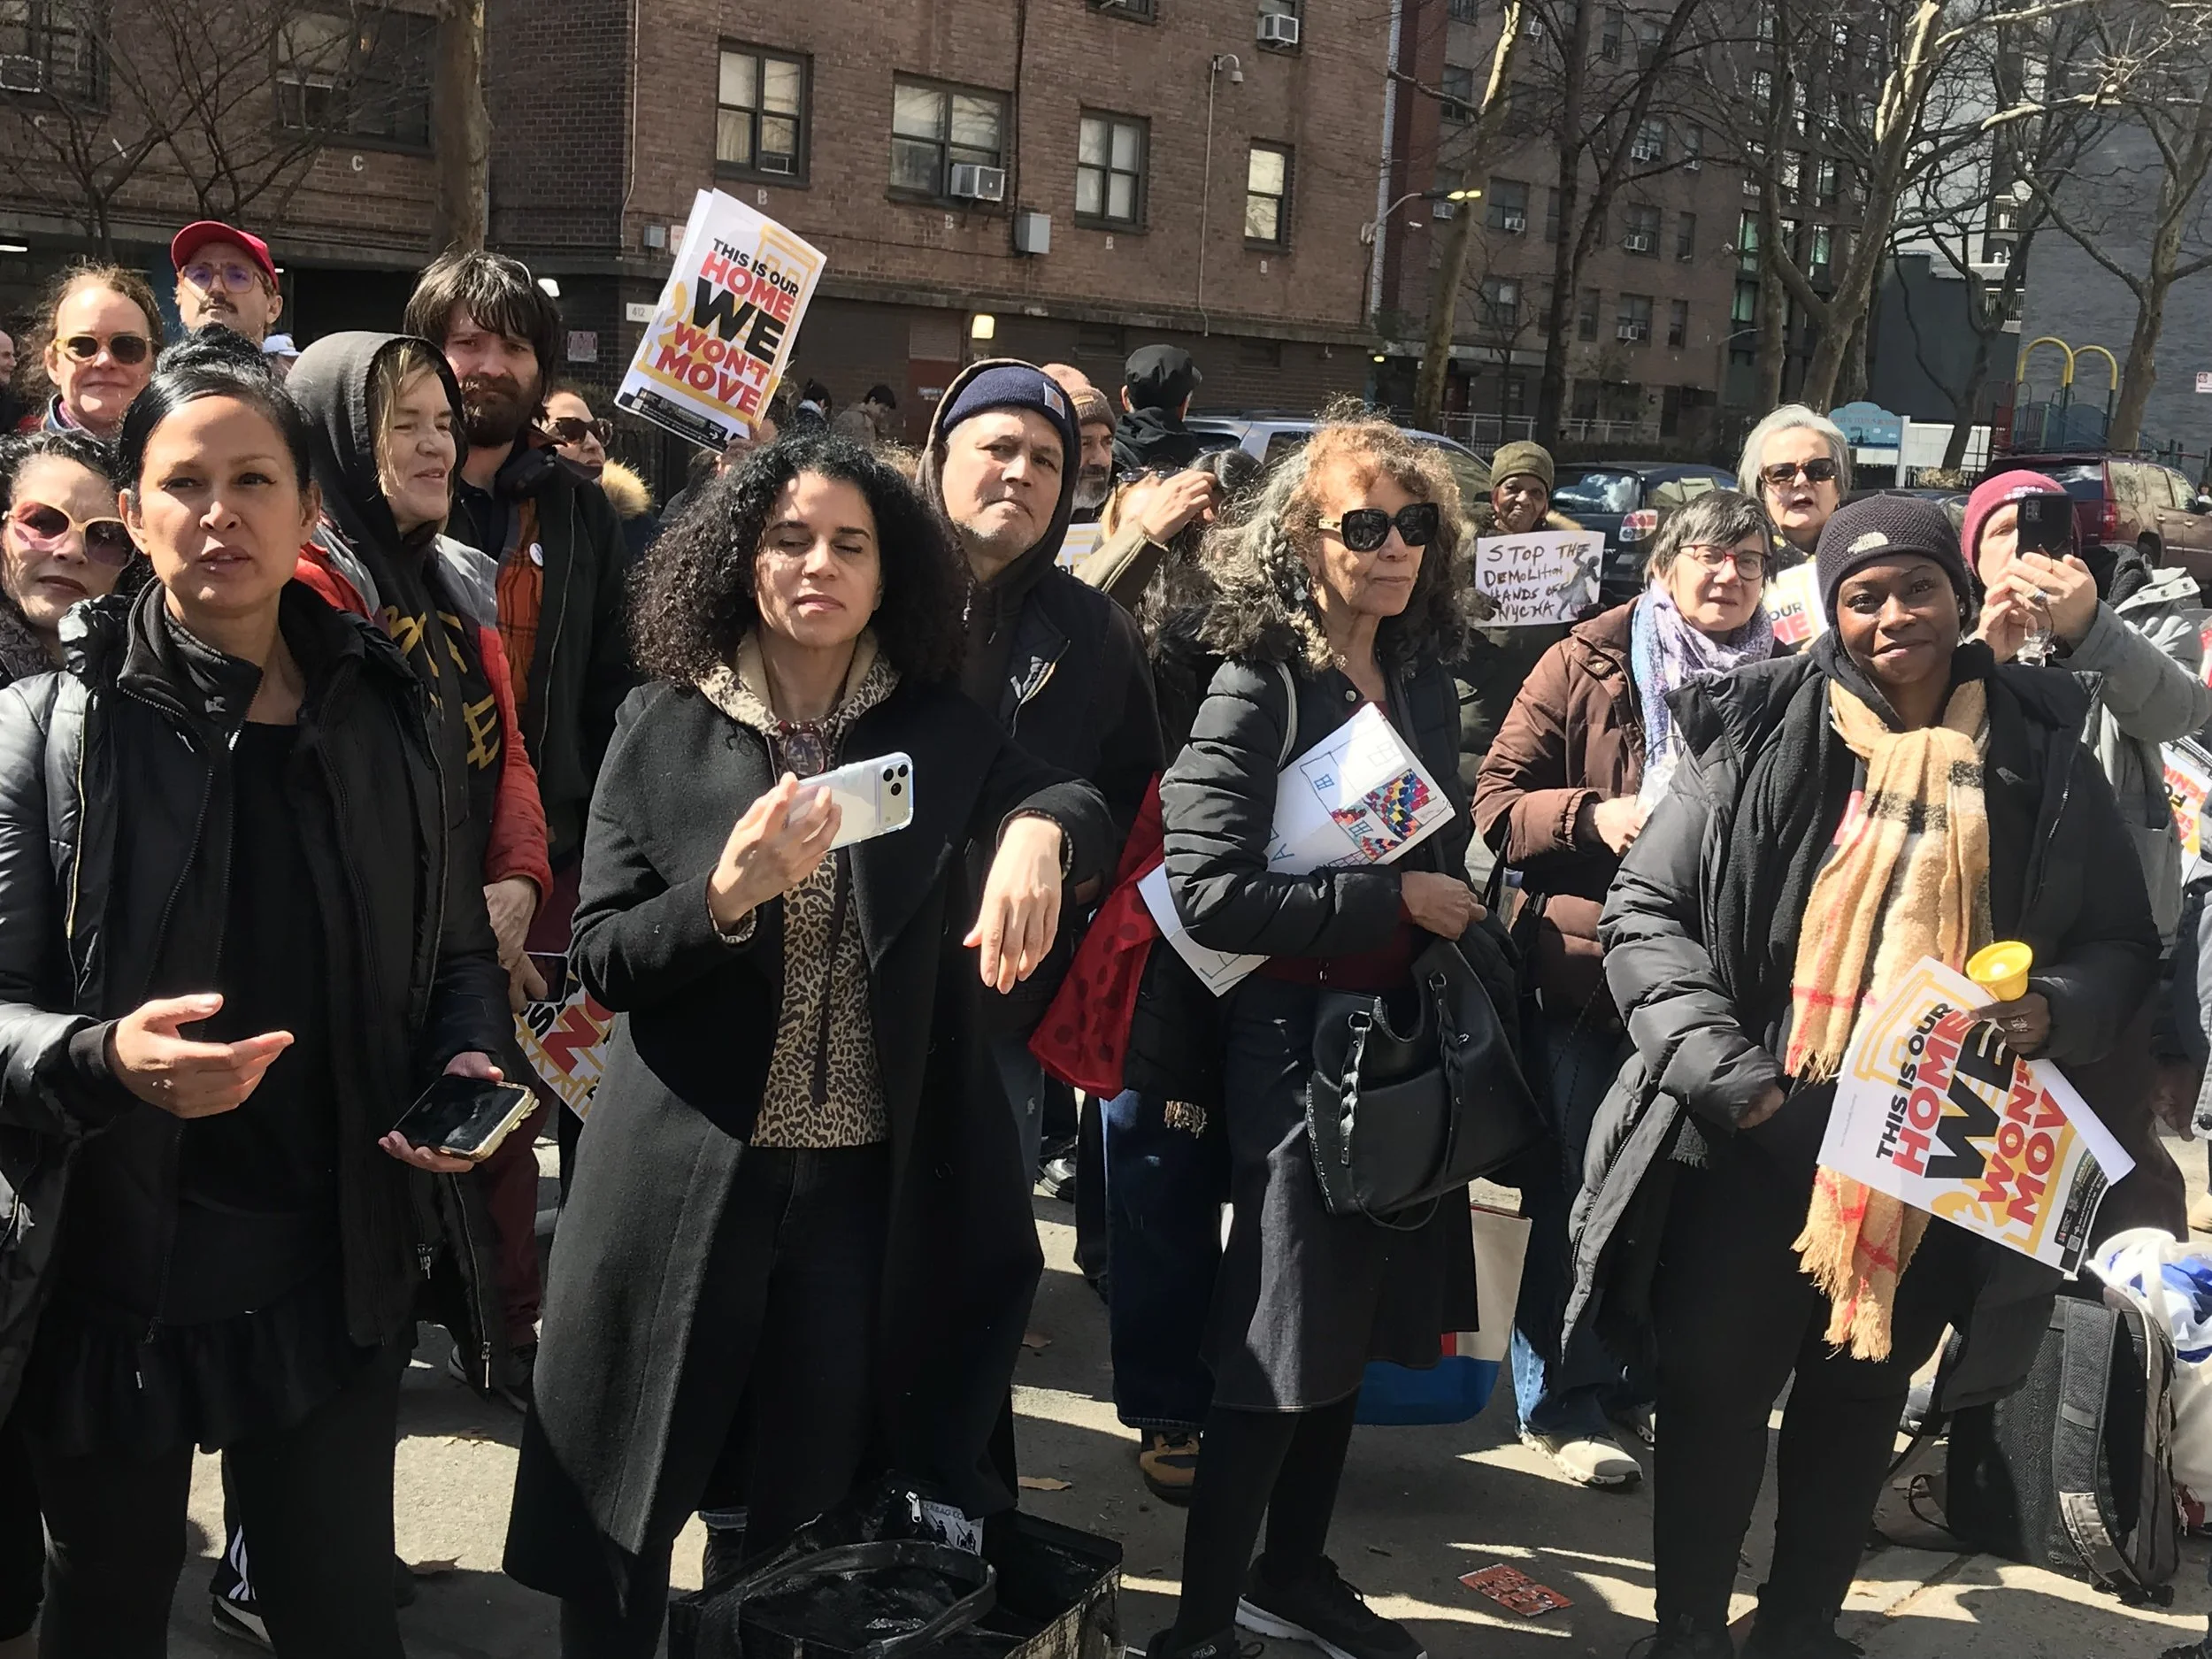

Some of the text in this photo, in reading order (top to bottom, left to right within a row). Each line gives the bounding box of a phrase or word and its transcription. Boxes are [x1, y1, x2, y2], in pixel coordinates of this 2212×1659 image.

[757, 189, 768, 205] B
[701, 251, 795, 323] HOME
[713, 238, 749, 268] THIS
[751, 259, 766, 278] IS
[769, 270, 800, 298] OUR
[673, 320, 772, 387] WON'T
[692, 276, 788, 365] WE
[655, 344, 764, 416] MOVE
[1486, 545, 1545, 566] STOP
[1498, 598, 1555, 624] NYCHA
[1770, 602, 1802, 621] OUR
[1875, 1002, 1953, 1159] THIS IS OUR
[1892, 1009, 1978, 1177] HOME
[1924, 1019, 2019, 1179] WE
[1978, 1059, 2038, 1202] WON'
[2007, 1087, 2069, 1226] MOV
